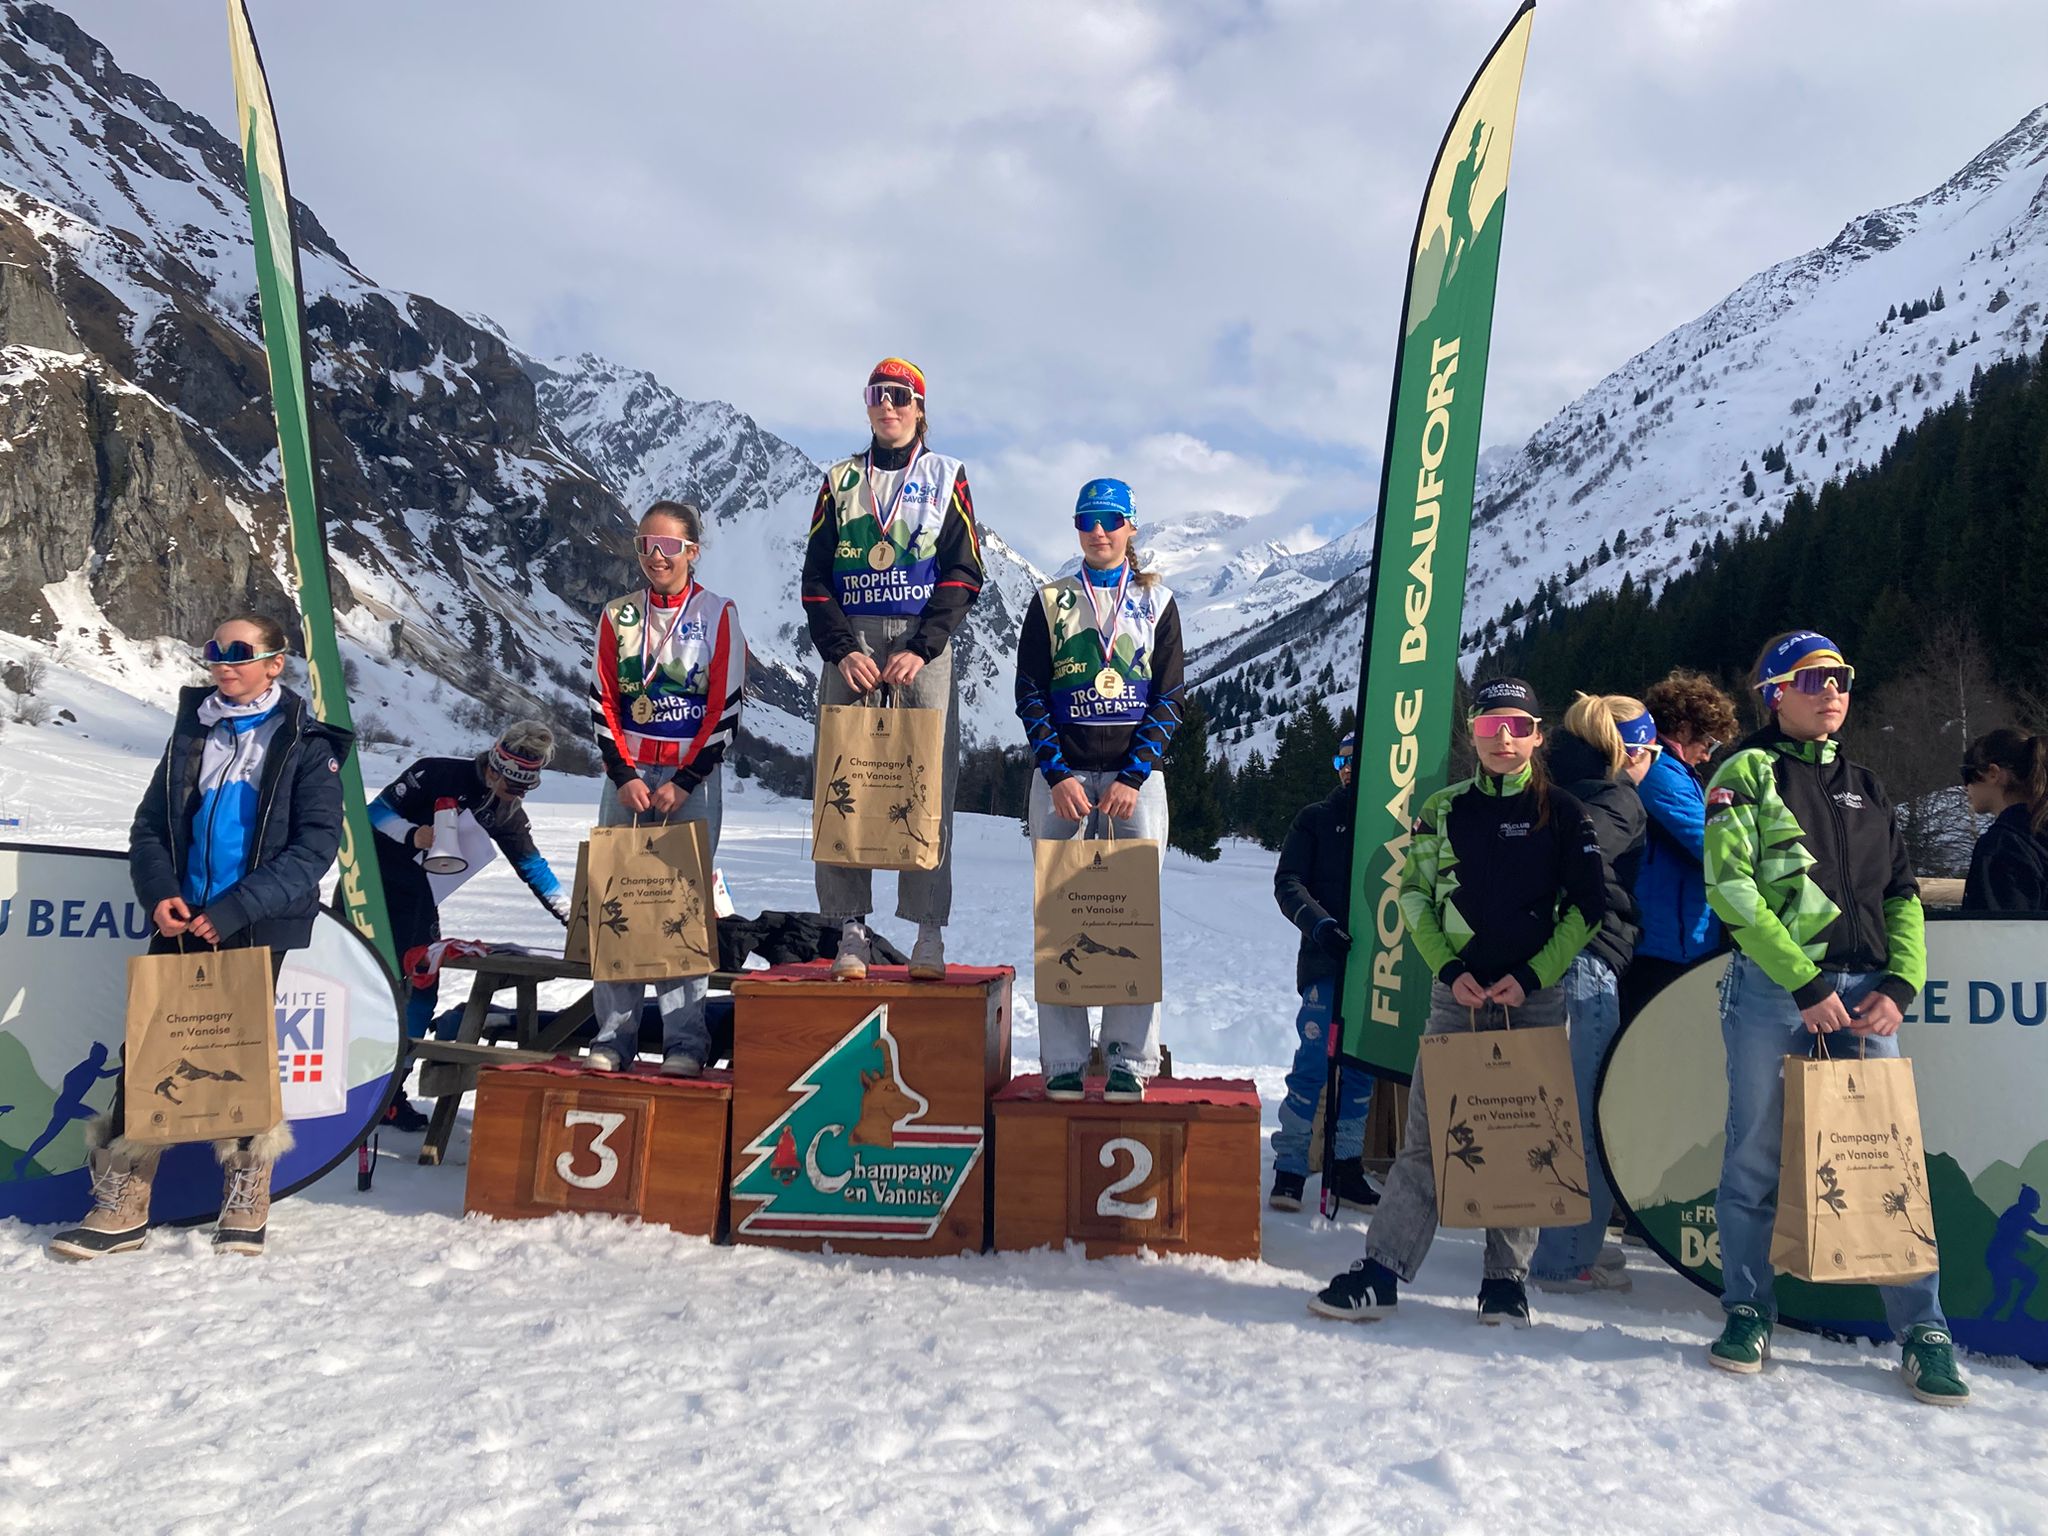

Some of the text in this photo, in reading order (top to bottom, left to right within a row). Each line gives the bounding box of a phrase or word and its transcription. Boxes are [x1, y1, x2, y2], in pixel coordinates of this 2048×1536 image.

[843, 567, 908, 590] TROPHÉE
[843, 583, 934, 605] DU BEAUFORT
[619, 604, 633, 624] 3
[1103, 675, 1115, 689] 2
[1370, 337, 1461, 1027] FROMAGE BEAUFORT
[1071, 681, 1137, 704] TROÉE
[637, 702, 647, 715] 3
[1070, 705, 1092, 718] DU
[849, 757, 905, 769] Champagny
[865, 771, 902, 781] Vanoise
[620, 877, 675, 887] Champagny
[637, 888, 673, 897] Vanoise
[1068, 892, 1127, 903] Champagny
[1085, 905, 1125, 914] Vanoise
[1969, 981, 2047, 1027] DU
[166, 1012, 233, 1024] Champagny
[187, 1025, 230, 1037] Vanoise
[1467, 1095, 1538, 1107] Champagny
[1473, 1109, 1536, 1121] en Vanoise
[1830, 1132, 1890, 1145] Champagny
[556, 1110, 627, 1190] 3
[1835, 1149, 1889, 1161] en Vanoise
[806, 1124, 954, 1194] Champagny
[1096, 1138, 1157, 1219] 2
[844, 1179, 943, 1205] en Vanoise
